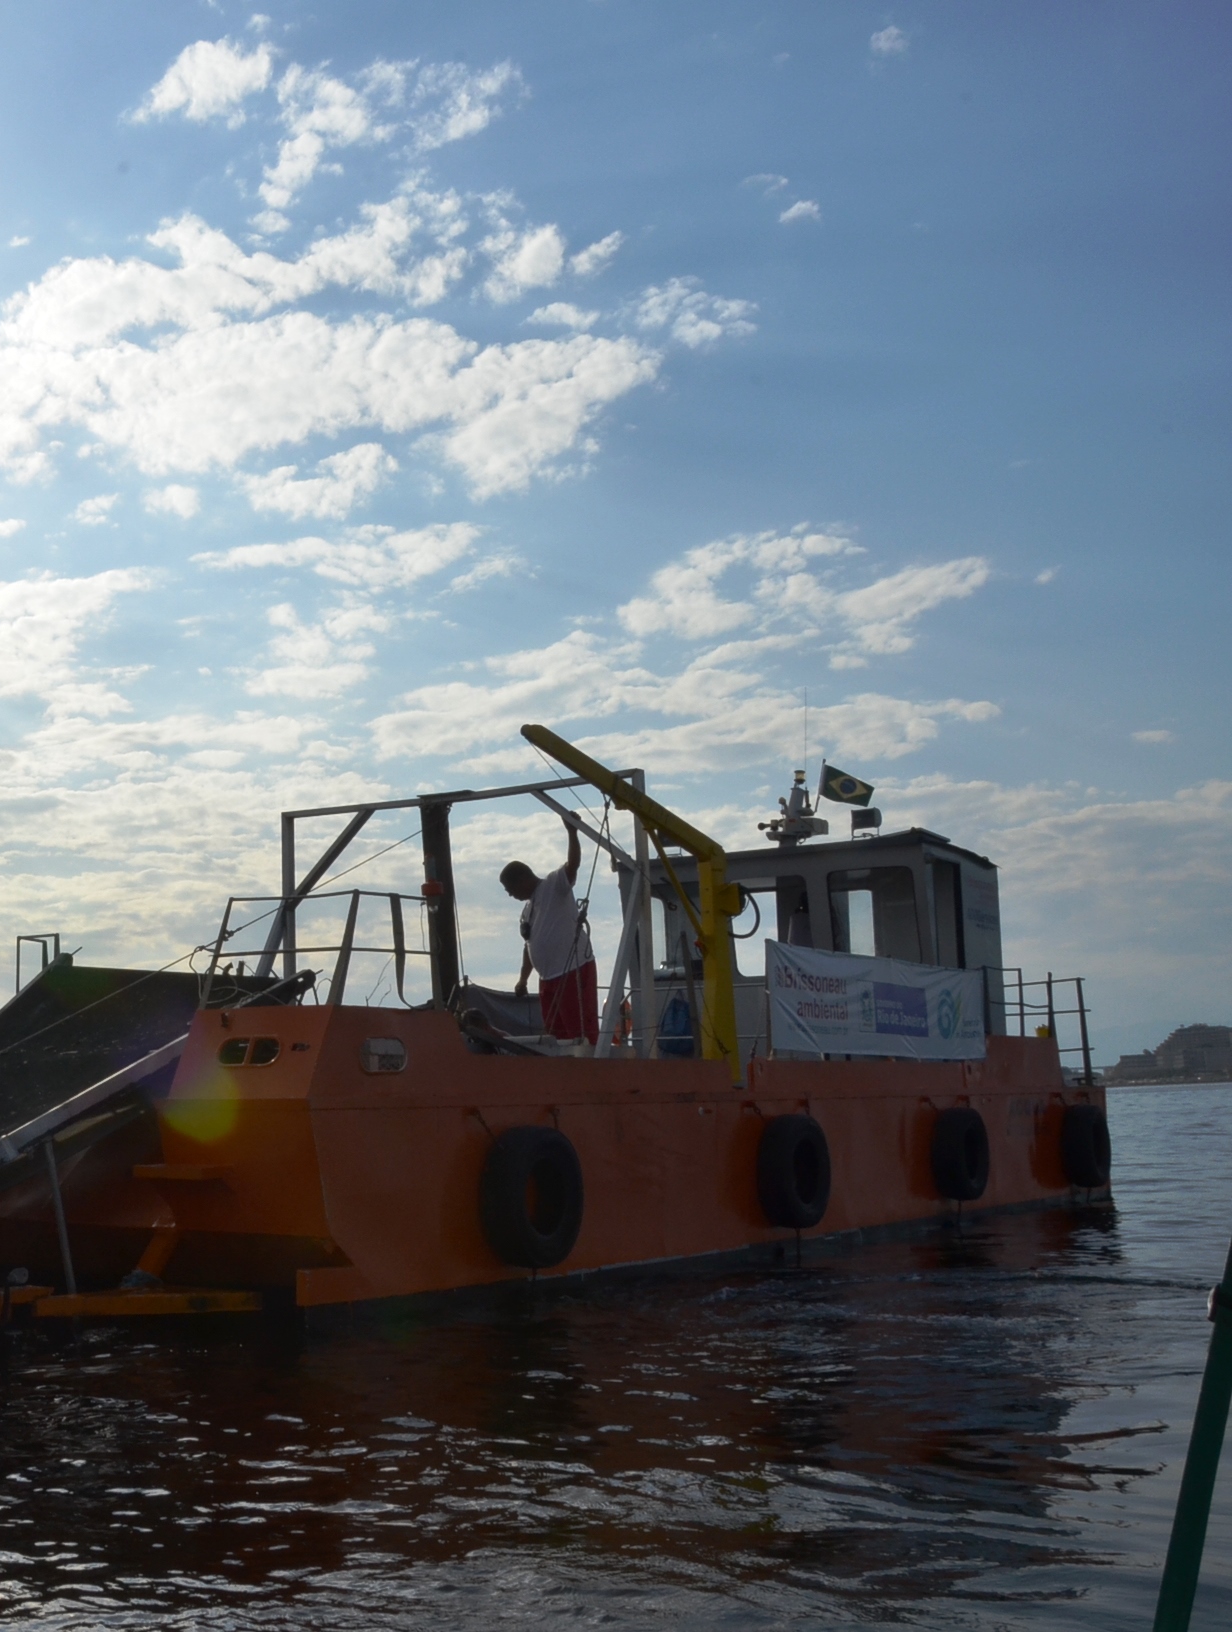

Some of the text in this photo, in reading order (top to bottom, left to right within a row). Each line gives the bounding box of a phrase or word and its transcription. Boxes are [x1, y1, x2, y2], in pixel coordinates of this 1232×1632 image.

[784, 965, 847, 994] Brissoneau
[797, 998, 848, 1020] ambiental
[877, 1009, 926, 1028] Rio de Janeiro
